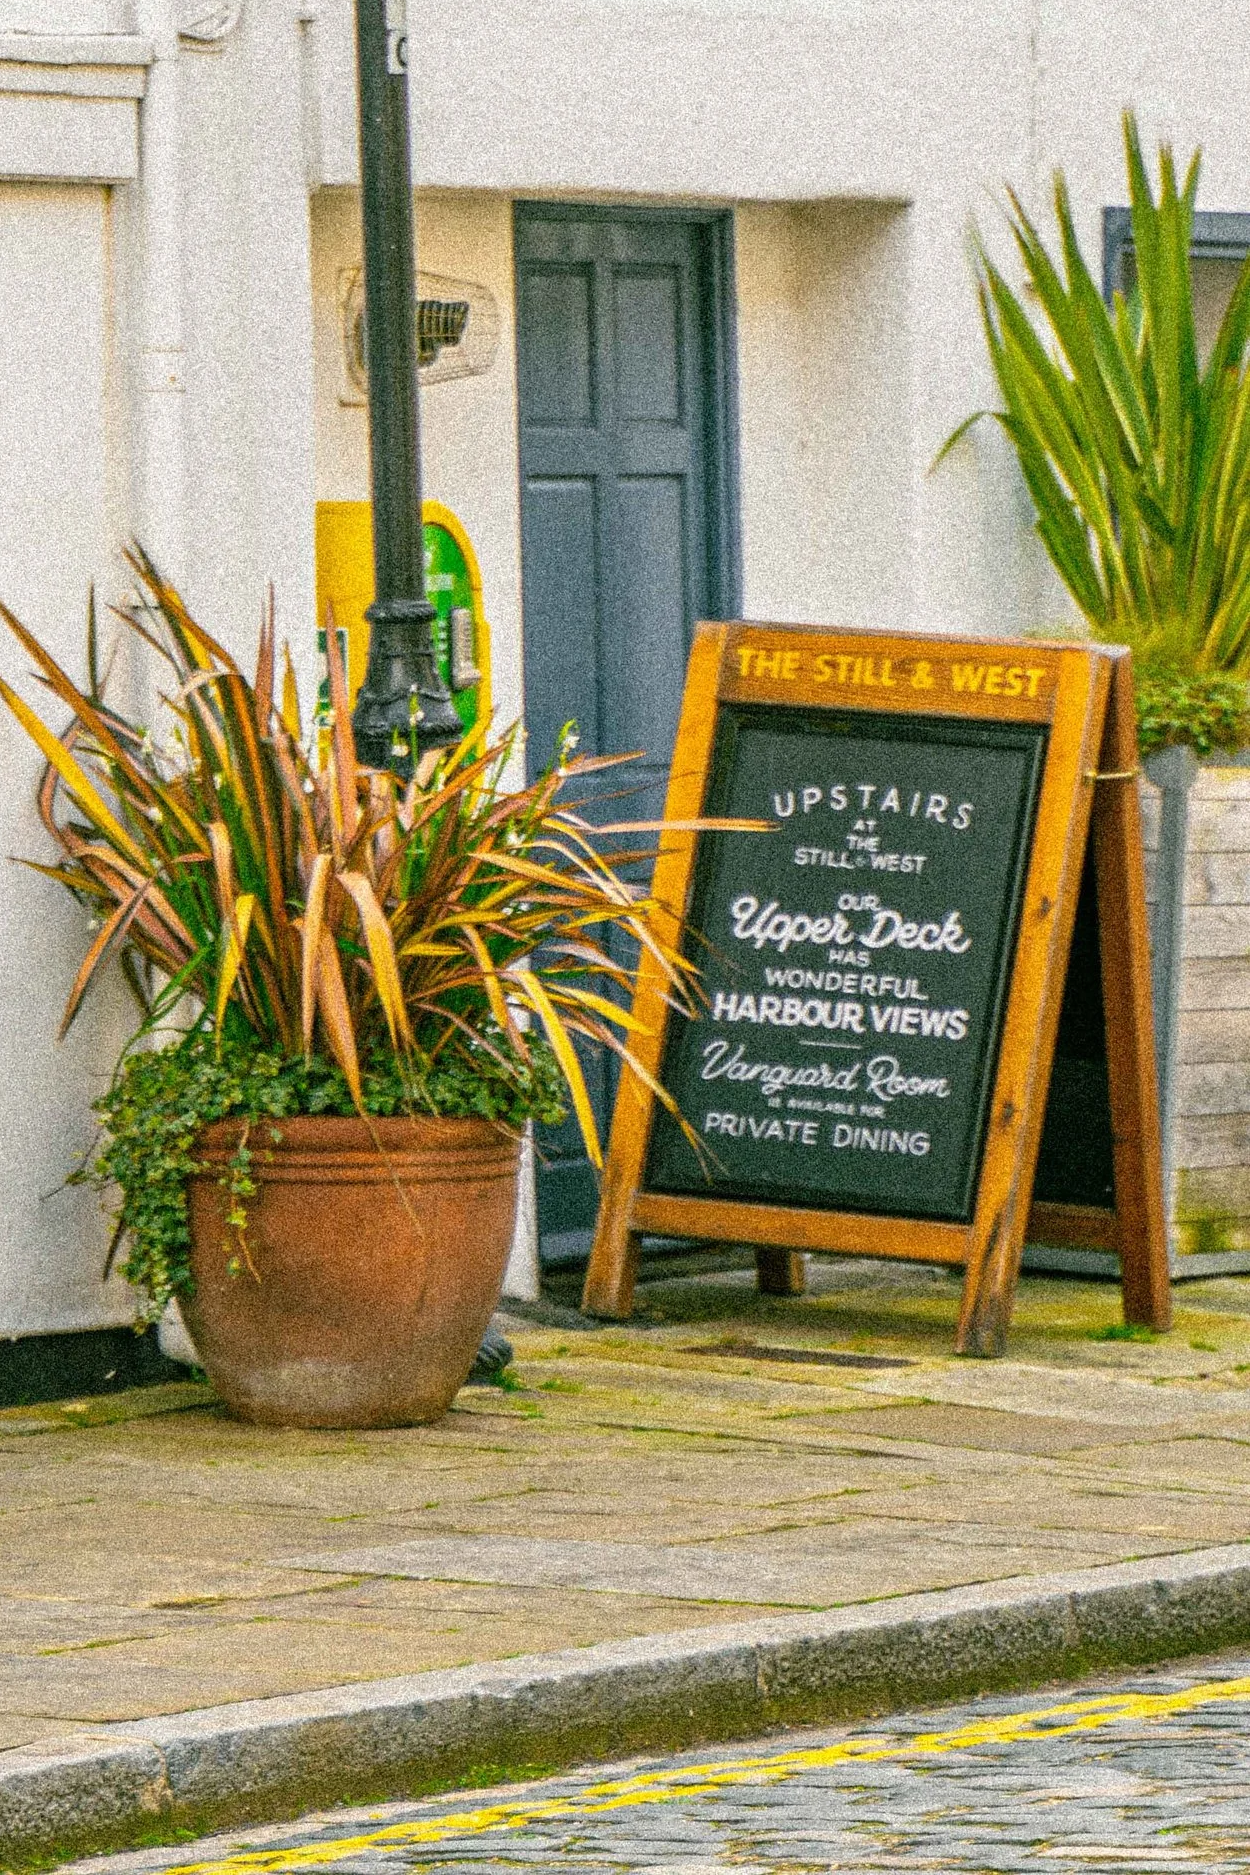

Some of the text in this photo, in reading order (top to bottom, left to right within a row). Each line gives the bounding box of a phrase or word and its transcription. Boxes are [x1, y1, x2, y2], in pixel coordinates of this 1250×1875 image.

[737, 648, 1046, 698] THE STILL & WEST
[773, 784, 976, 830] UPSTAIRS
[853, 819, 877, 832] AT
[794, 846, 856, 869] STILL
[870, 853, 928, 874] WEST
[846, 834, 881, 852] THE
[838, 893, 881, 912] OUR
[731, 895, 972, 954] Upper Deck
[828, 949, 871, 968] HAS
[764, 967, 929, 1001] WONDERFUL
[712, 991, 970, 1041] HARBOUR VIEWS
[700, 1040, 951, 1102] Vanguard Room
[704, 1112, 931, 1156] PRIVATE DINING
